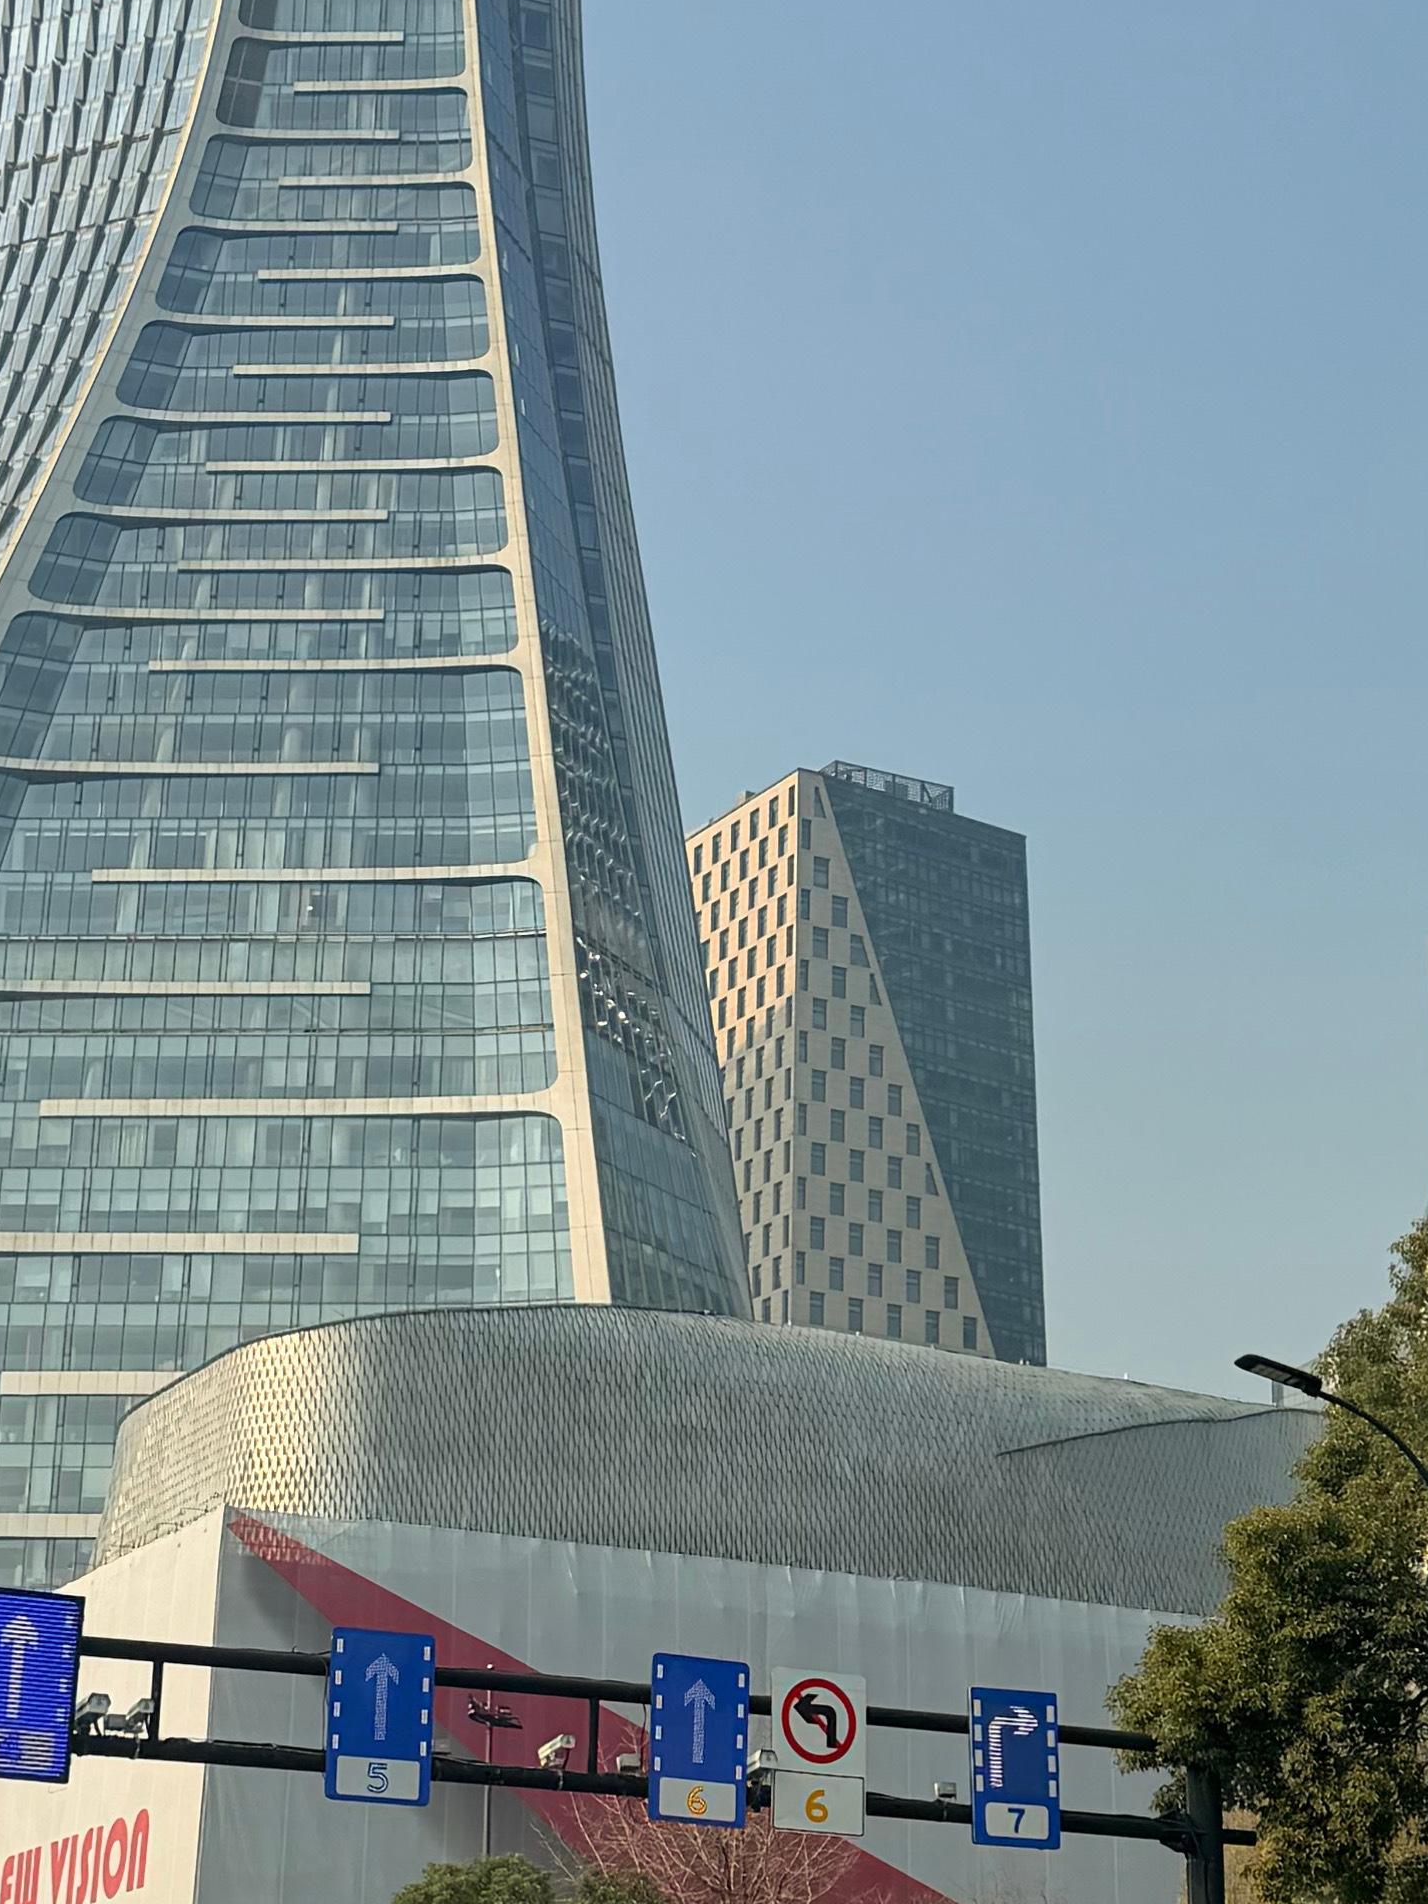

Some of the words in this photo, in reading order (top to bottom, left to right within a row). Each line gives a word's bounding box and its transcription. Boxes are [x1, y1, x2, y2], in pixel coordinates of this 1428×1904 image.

[367, 1762, 389, 1794] 5
[686, 1785, 708, 1815] 6
[804, 1789, 829, 1823] 6
[1007, 1807, 1026, 1834] 7
